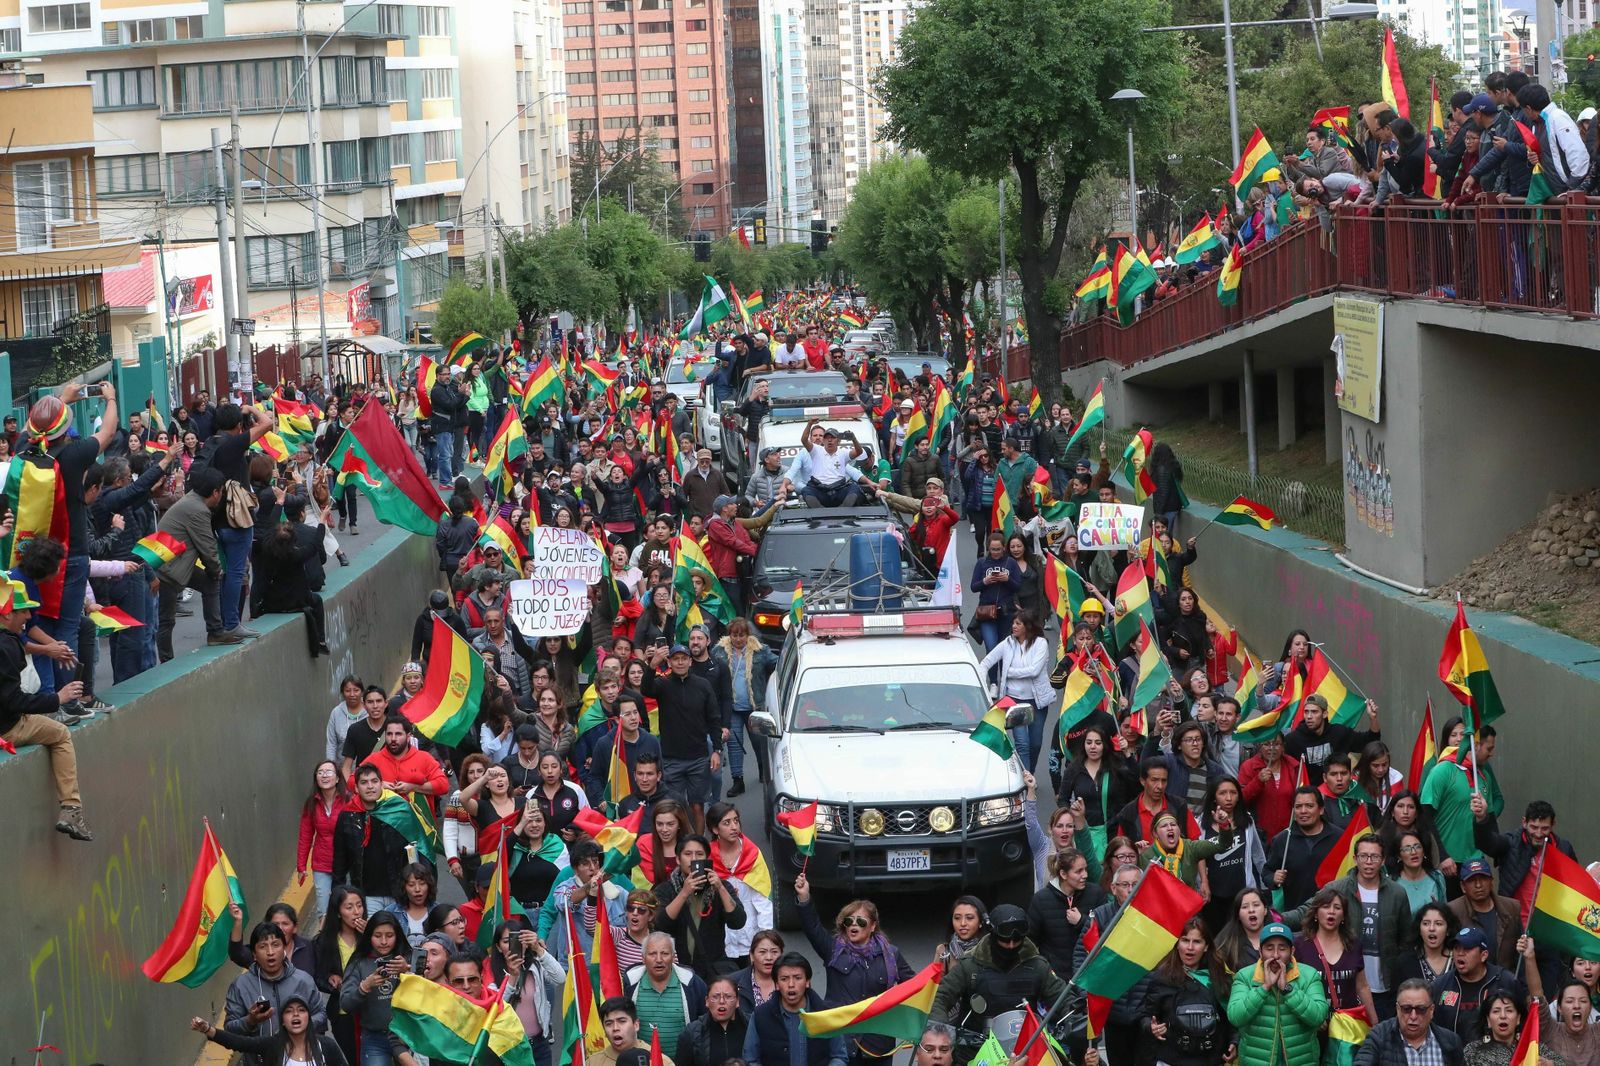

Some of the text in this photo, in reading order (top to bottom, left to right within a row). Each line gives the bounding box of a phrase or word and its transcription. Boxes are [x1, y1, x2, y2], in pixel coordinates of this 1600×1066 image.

[1083, 506, 1122, 517] BOLIVIA
[1080, 529, 1139, 547] CAMACHO
[540, 546, 599, 562] JÓVENES
[533, 566, 553, 579] CON
[532, 579, 569, 596] DIOS
[513, 598, 549, 615] TODO
[520, 617, 527, 630] Y
[531, 615, 546, 629] LO
[890, 857, 928, 869] 4837PFX
